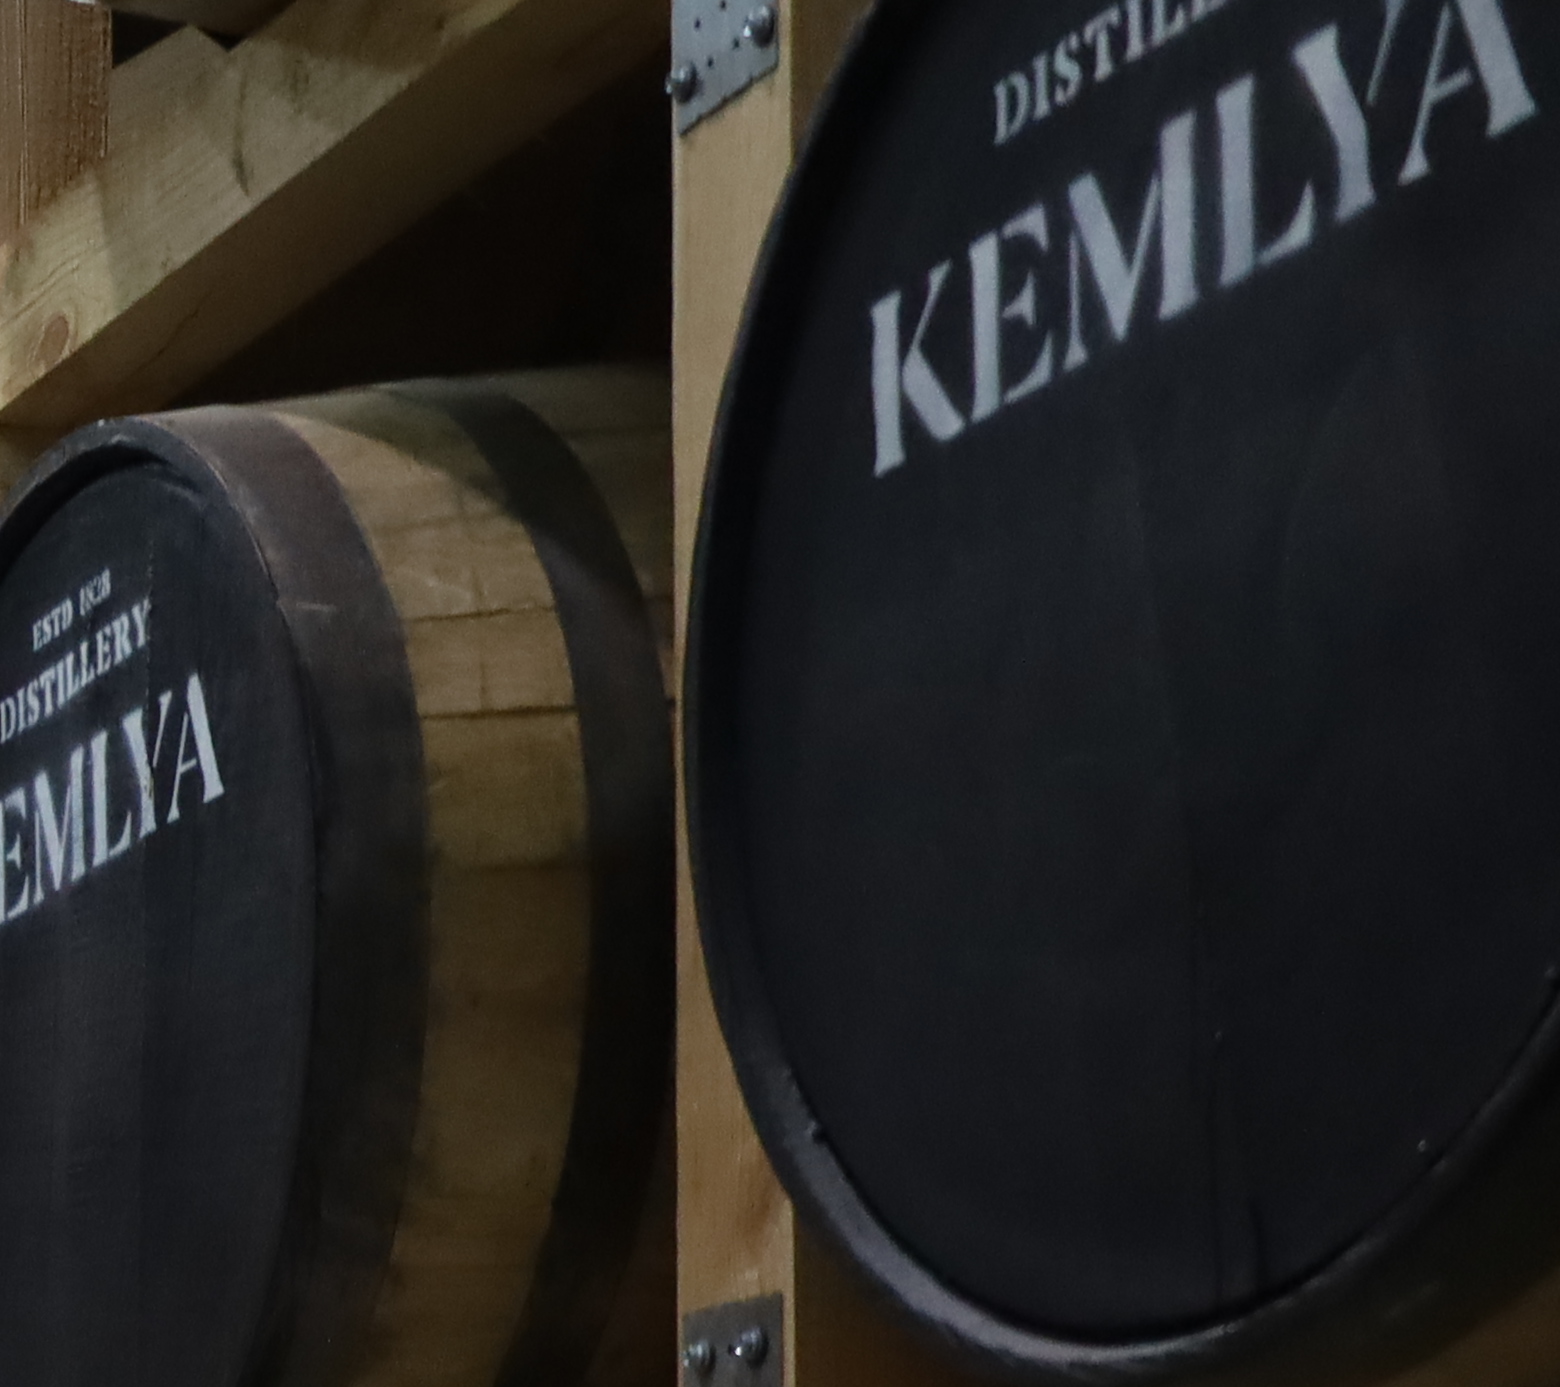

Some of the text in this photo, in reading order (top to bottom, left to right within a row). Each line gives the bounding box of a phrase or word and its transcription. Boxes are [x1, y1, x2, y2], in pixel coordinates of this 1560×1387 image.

[992, 0, 1224, 146] DISTIL
[870, 0, 1537, 478] KEMLYA
[0, 598, 152, 744] DISTILLERY
[32, 598, 73, 652] ESTD
